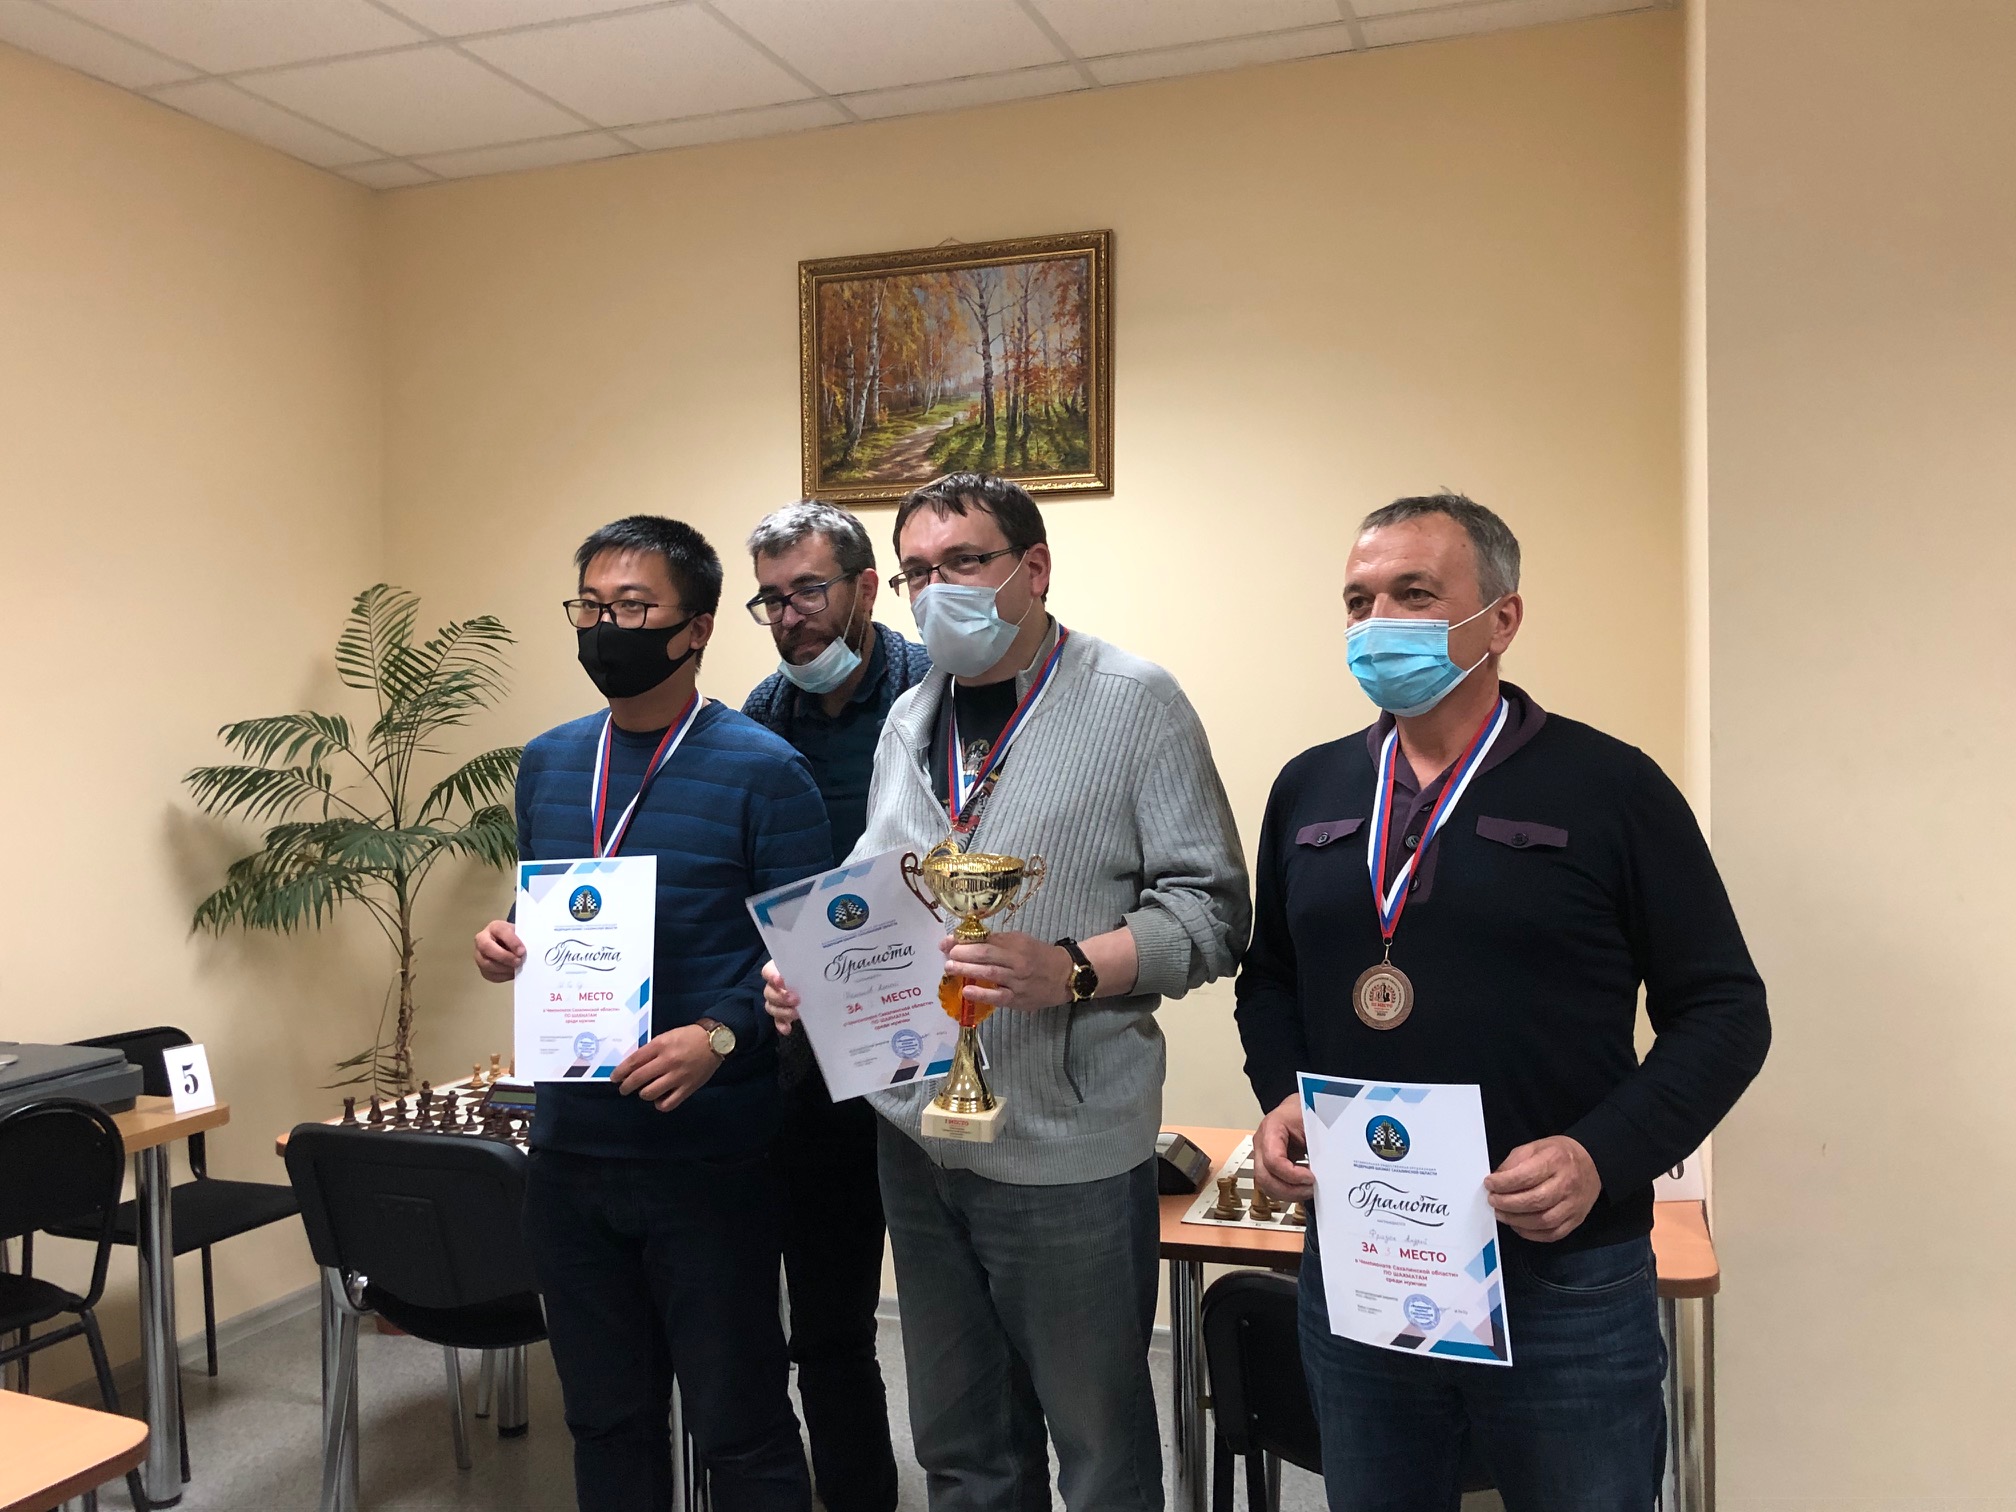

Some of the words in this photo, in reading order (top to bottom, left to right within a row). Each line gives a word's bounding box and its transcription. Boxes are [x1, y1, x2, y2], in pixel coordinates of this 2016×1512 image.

[544, 939, 622, 971] Грамота
[824, 943, 915, 984] Грамота
[549, 993, 563, 1002] ЗА
[578, 991, 614, 1001] МЕСТО
[846, 1002, 863, 1015] ЗА
[881, 987, 921, 1005] МЕСТО
[182, 1062, 199, 1094] 5
[1348, 1180, 1450, 1227] Грамота
[1361, 1241, 1379, 1254] ЗА
[1399, 1247, 1447, 1263] МЕСТО
[1392, 1271, 1428, 1281] ШАХМАТАМ
